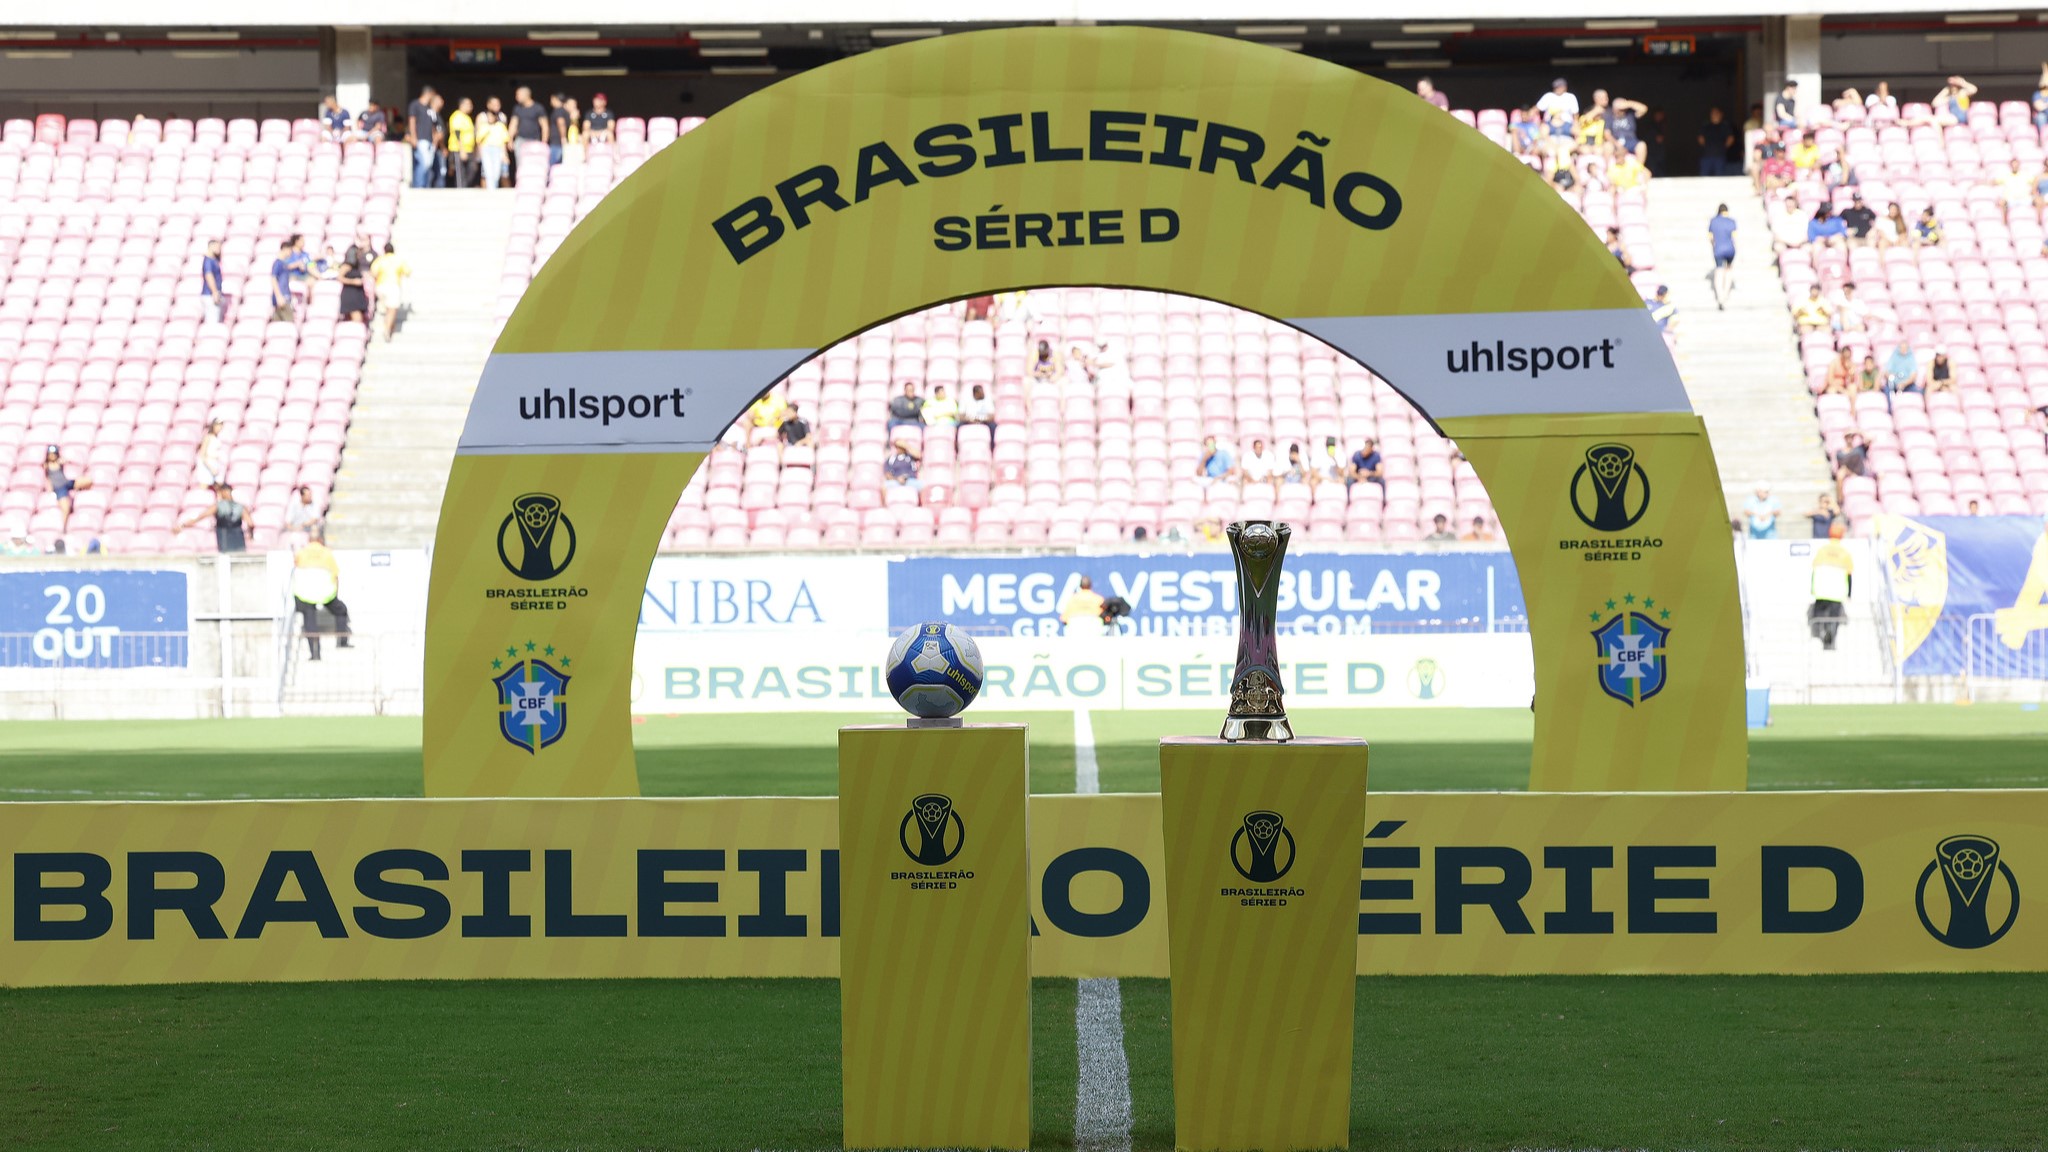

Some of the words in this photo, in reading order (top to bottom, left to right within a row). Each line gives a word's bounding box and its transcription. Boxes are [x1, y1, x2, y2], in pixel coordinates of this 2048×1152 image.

[711, 109, 1403, 265] BRASILEIRÃO
[934, 204, 1125, 251] SÉRIE
[1140, 207, 1180, 243] D
[1560, 536, 1663, 550] BRASILEIRÃO
[1584, 550, 1629, 561] SÉRIE
[1631, 551, 1641, 561] D
[486, 586, 588, 599] BRASILEIRÃO
[1108, 569, 1441, 612] VESTBULAR
[43, 584, 106, 625] 20
[510, 599, 554, 611] SÉRIE
[556, 600, 567, 610] D
[637, 578, 826, 625] NIBRA
[32, 626, 121, 661] OUT
[1617, 649, 1646, 663] CBF
[664, 653, 1107, 698] BRASILRÃO
[1348, 662, 1386, 695] D
[946, 667, 977, 695] uhlspor
[518, 696, 547, 710] CBF
[14, 847, 1151, 942] BRASILEIO
[1358, 820, 1718, 936] ÉRIE
[1760, 845, 1865, 934] D
[891, 868, 975, 880] BRASILEIRÃO
[910, 879, 947, 890] SÉRIE
[947, 881, 957, 890] D
[1220, 886, 1305, 897] BRASILEIRÃO
[1240, 896, 1277, 908] SÉRIE
[1278, 898, 1288, 907] D
